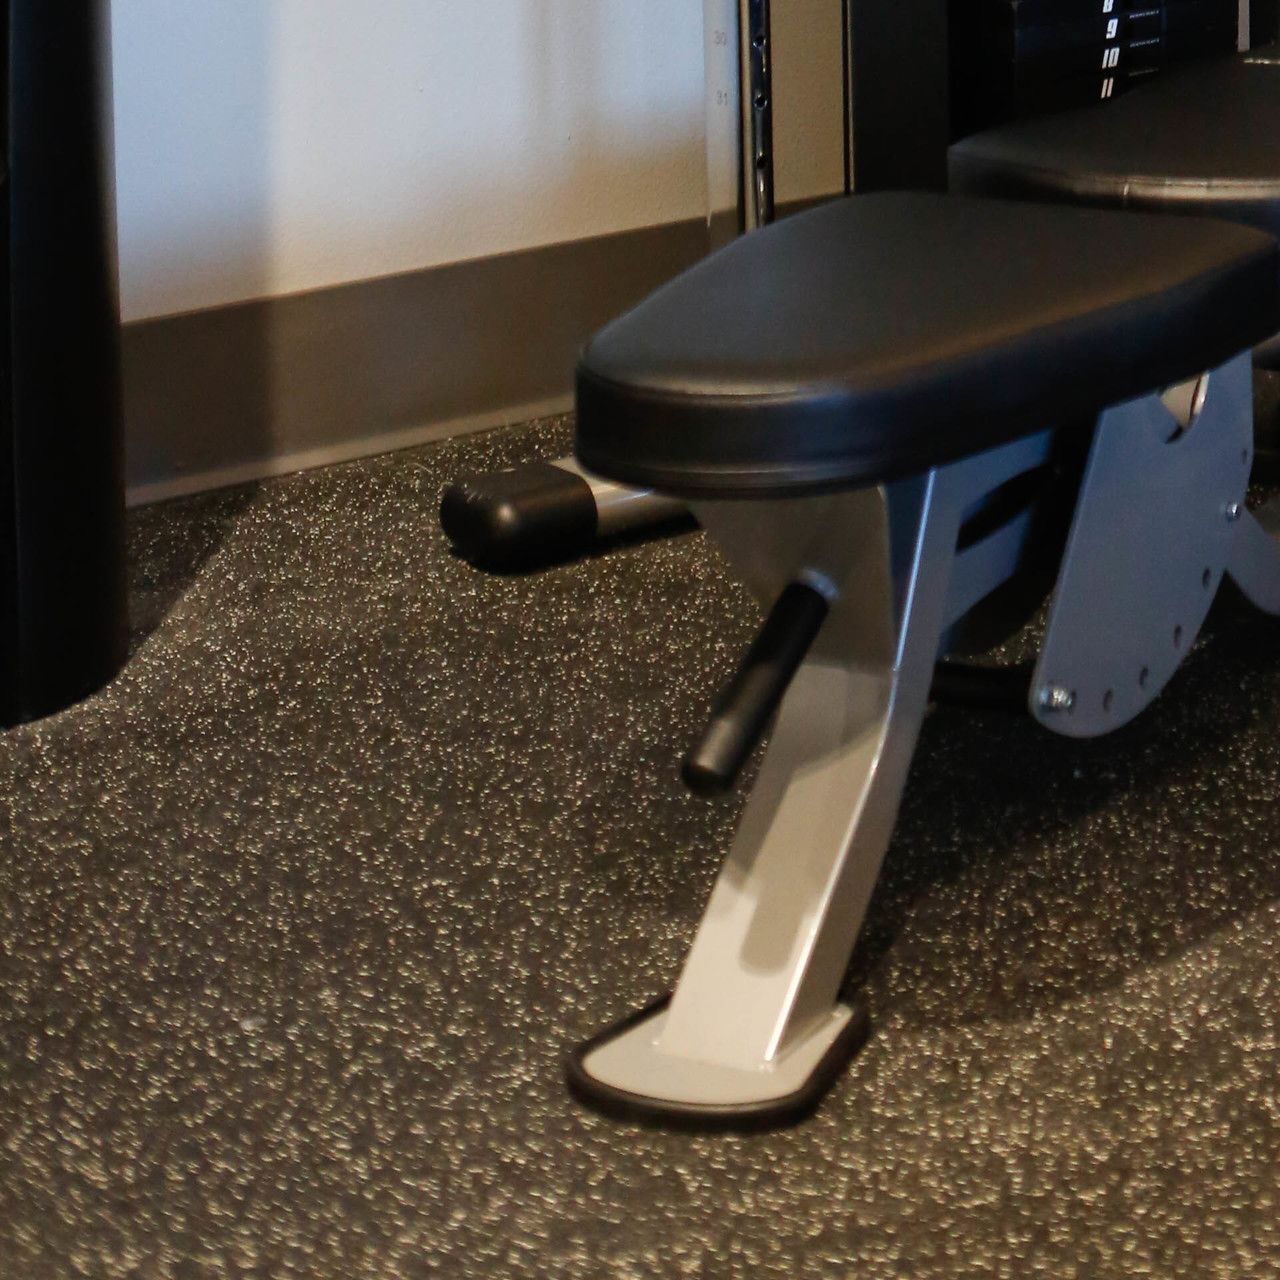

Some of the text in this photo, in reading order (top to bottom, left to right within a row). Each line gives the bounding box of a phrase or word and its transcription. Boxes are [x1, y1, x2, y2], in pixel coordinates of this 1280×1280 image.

[1105, 18, 1118, 39] 9
[1102, 47, 1120, 70] 10
[1101, 77, 1114, 99] 11
